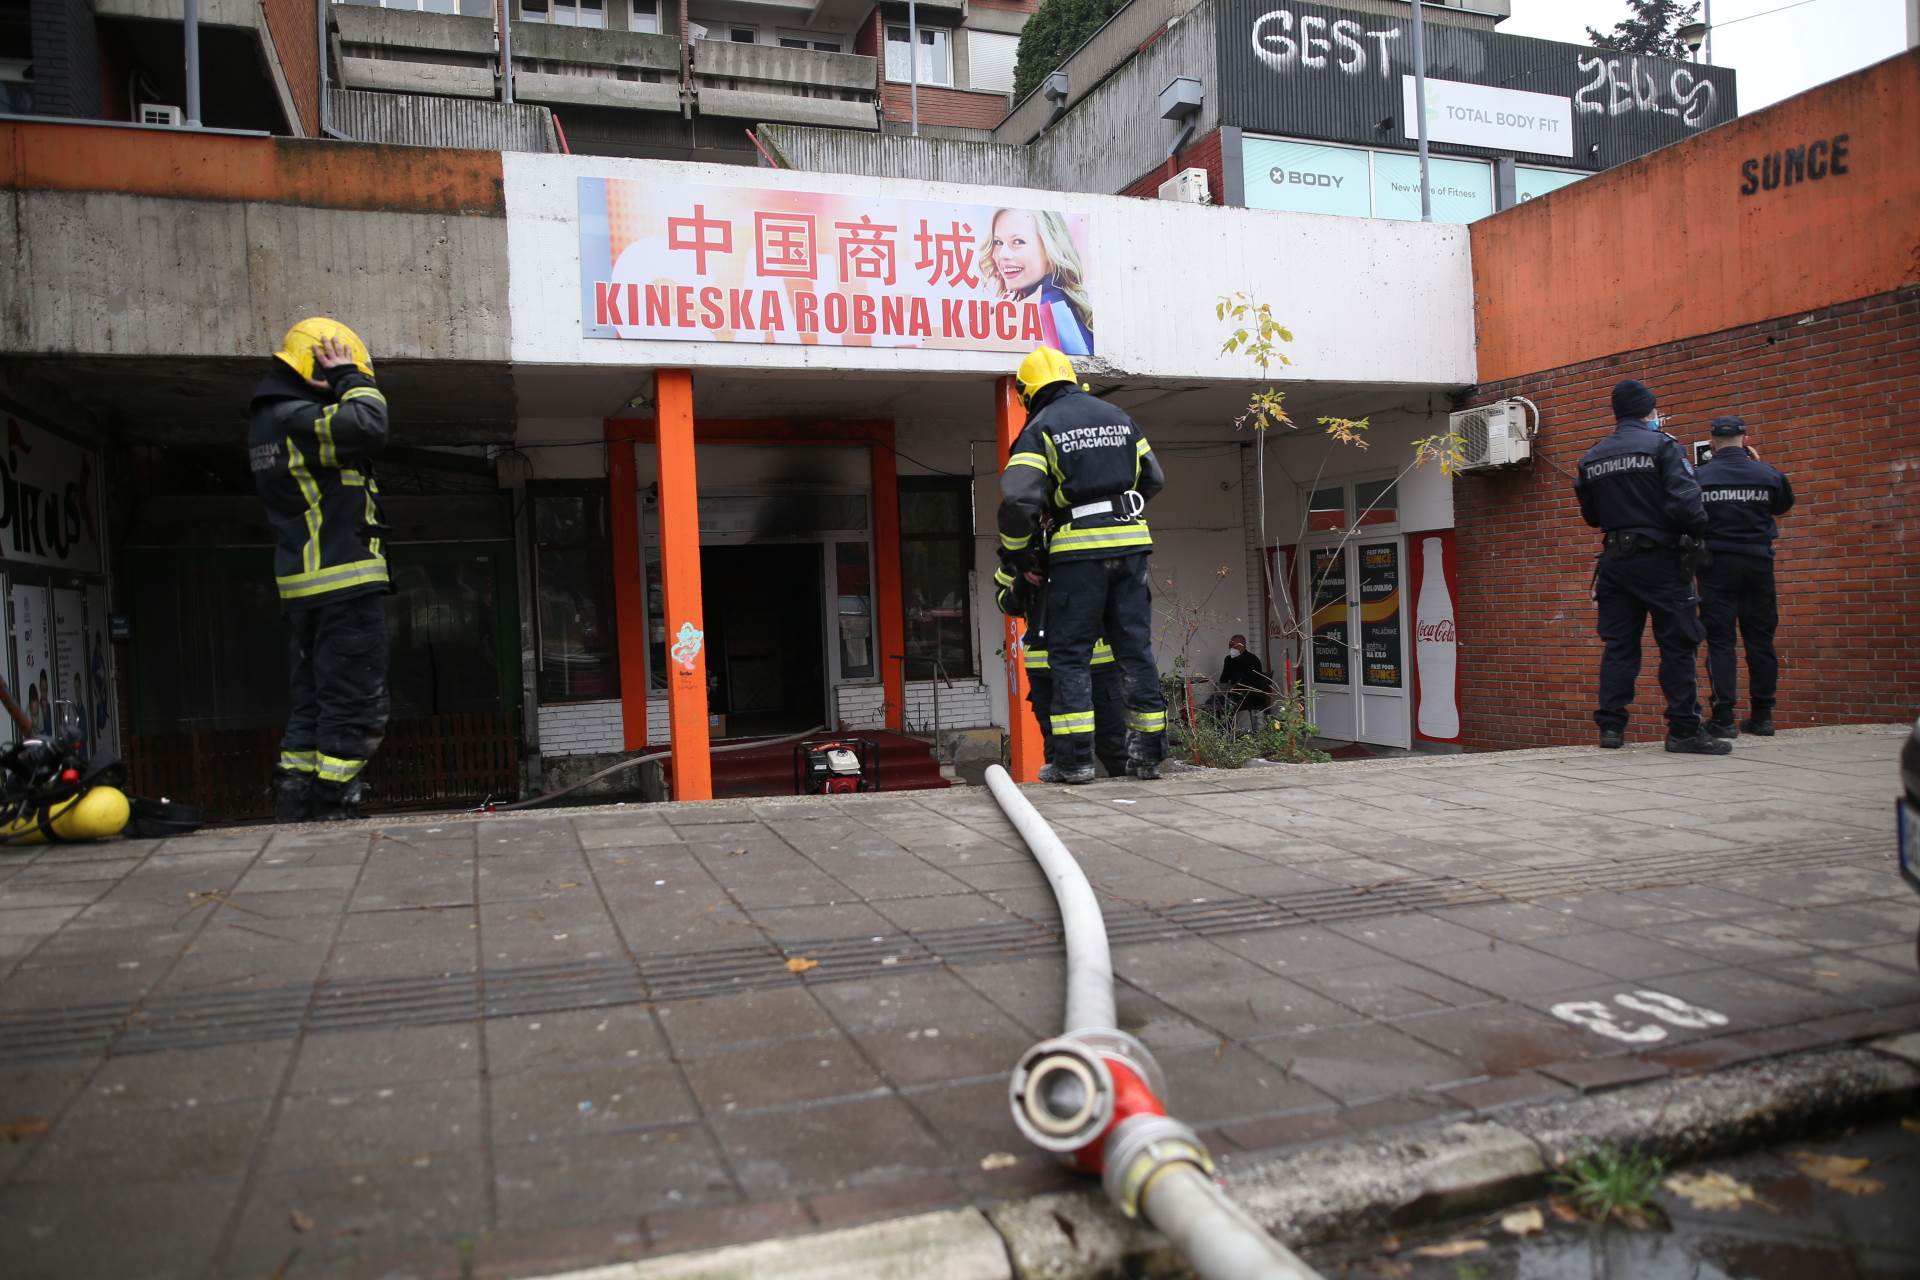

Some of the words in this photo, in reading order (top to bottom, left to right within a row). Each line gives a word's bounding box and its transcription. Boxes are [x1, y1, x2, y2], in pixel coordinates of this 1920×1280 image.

[1251, 9, 1400, 78] GEST
[1446, 105, 1493, 126] TOTAL
[1496, 111, 1535, 131] BODY
[1539, 118, 1559, 133] FIT
[1741, 134, 1850, 196] SUNCE
[1391, 182, 1411, 193] New
[1412, 184, 1435, 195] We
[1438, 186, 1447, 196] of
[1448, 187, 1476, 199] Fitness
[667, 203, 981, 289] 中国商城
[594, 282, 786, 333] KINESKA
[796, 290, 932, 338] ROBNA
[1052, 425, 1131, 445] ВАТРОГАСЦИ
[1061, 436, 1127, 453] СПАСИОЦИ
[1586, 455, 1655, 480] ПОЛИЦИЈА
[1701, 489, 1769, 503] ПОЛИЦИЈА
[1417, 619, 1455, 642] Coca-Cola
